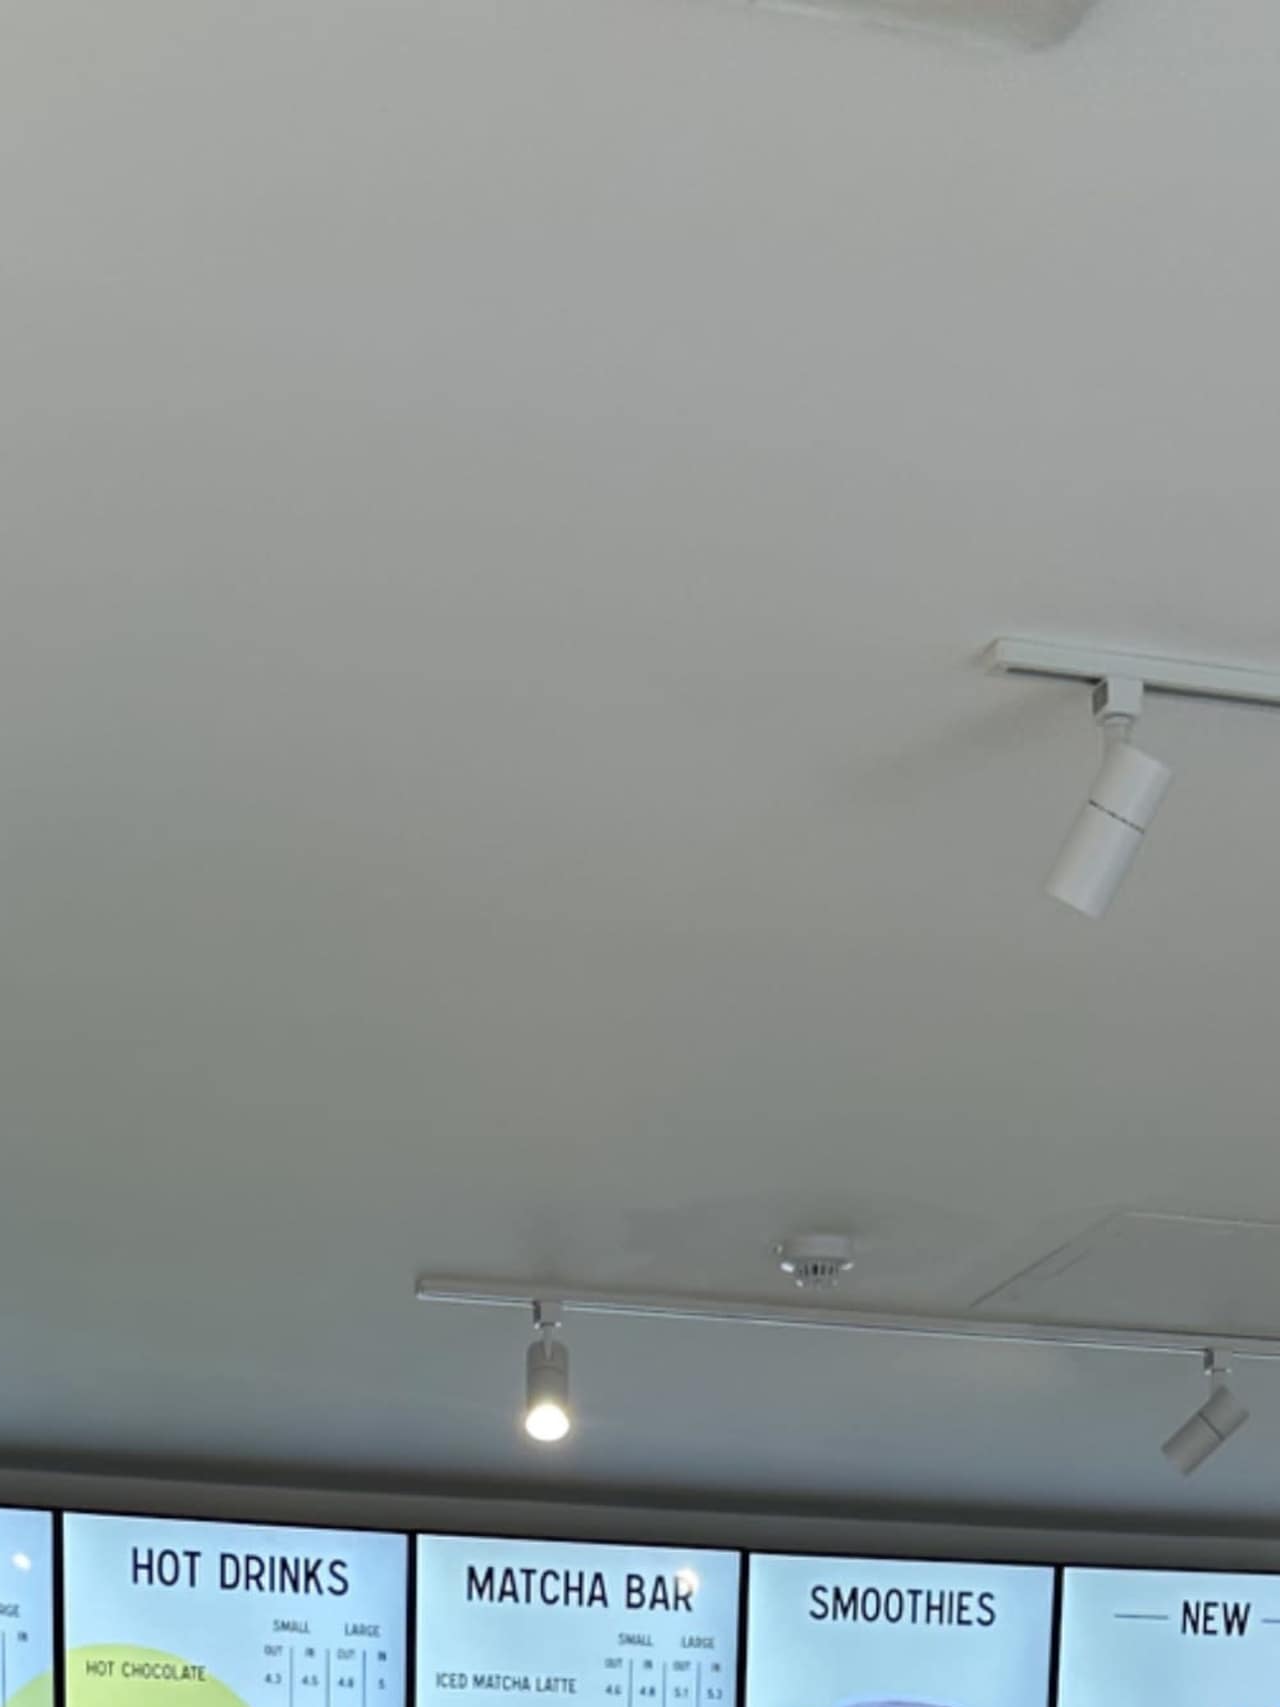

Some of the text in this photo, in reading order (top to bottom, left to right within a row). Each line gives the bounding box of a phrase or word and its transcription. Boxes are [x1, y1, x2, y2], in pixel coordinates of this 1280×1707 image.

[131, 1547, 349, 1596] HOT DRINKS
[466, 1565, 693, 1612] MATCHA BAR
[808, 1584, 996, 1627] SMOOTHIES
[1181, 1601, 1251, 1636] NEW
[273, 1620, 380, 1638] SMALL LARGE
[619, 1633, 653, 1647] SMALL
[86, 1661, 114, 1676] HOT
[122, 1662, 206, 1681] CHOCOLATE
[436, 1672, 467, 1689] ICED
[473, 1674, 530, 1690] MATCHA
[536, 1677, 576, 1694] LATTE
